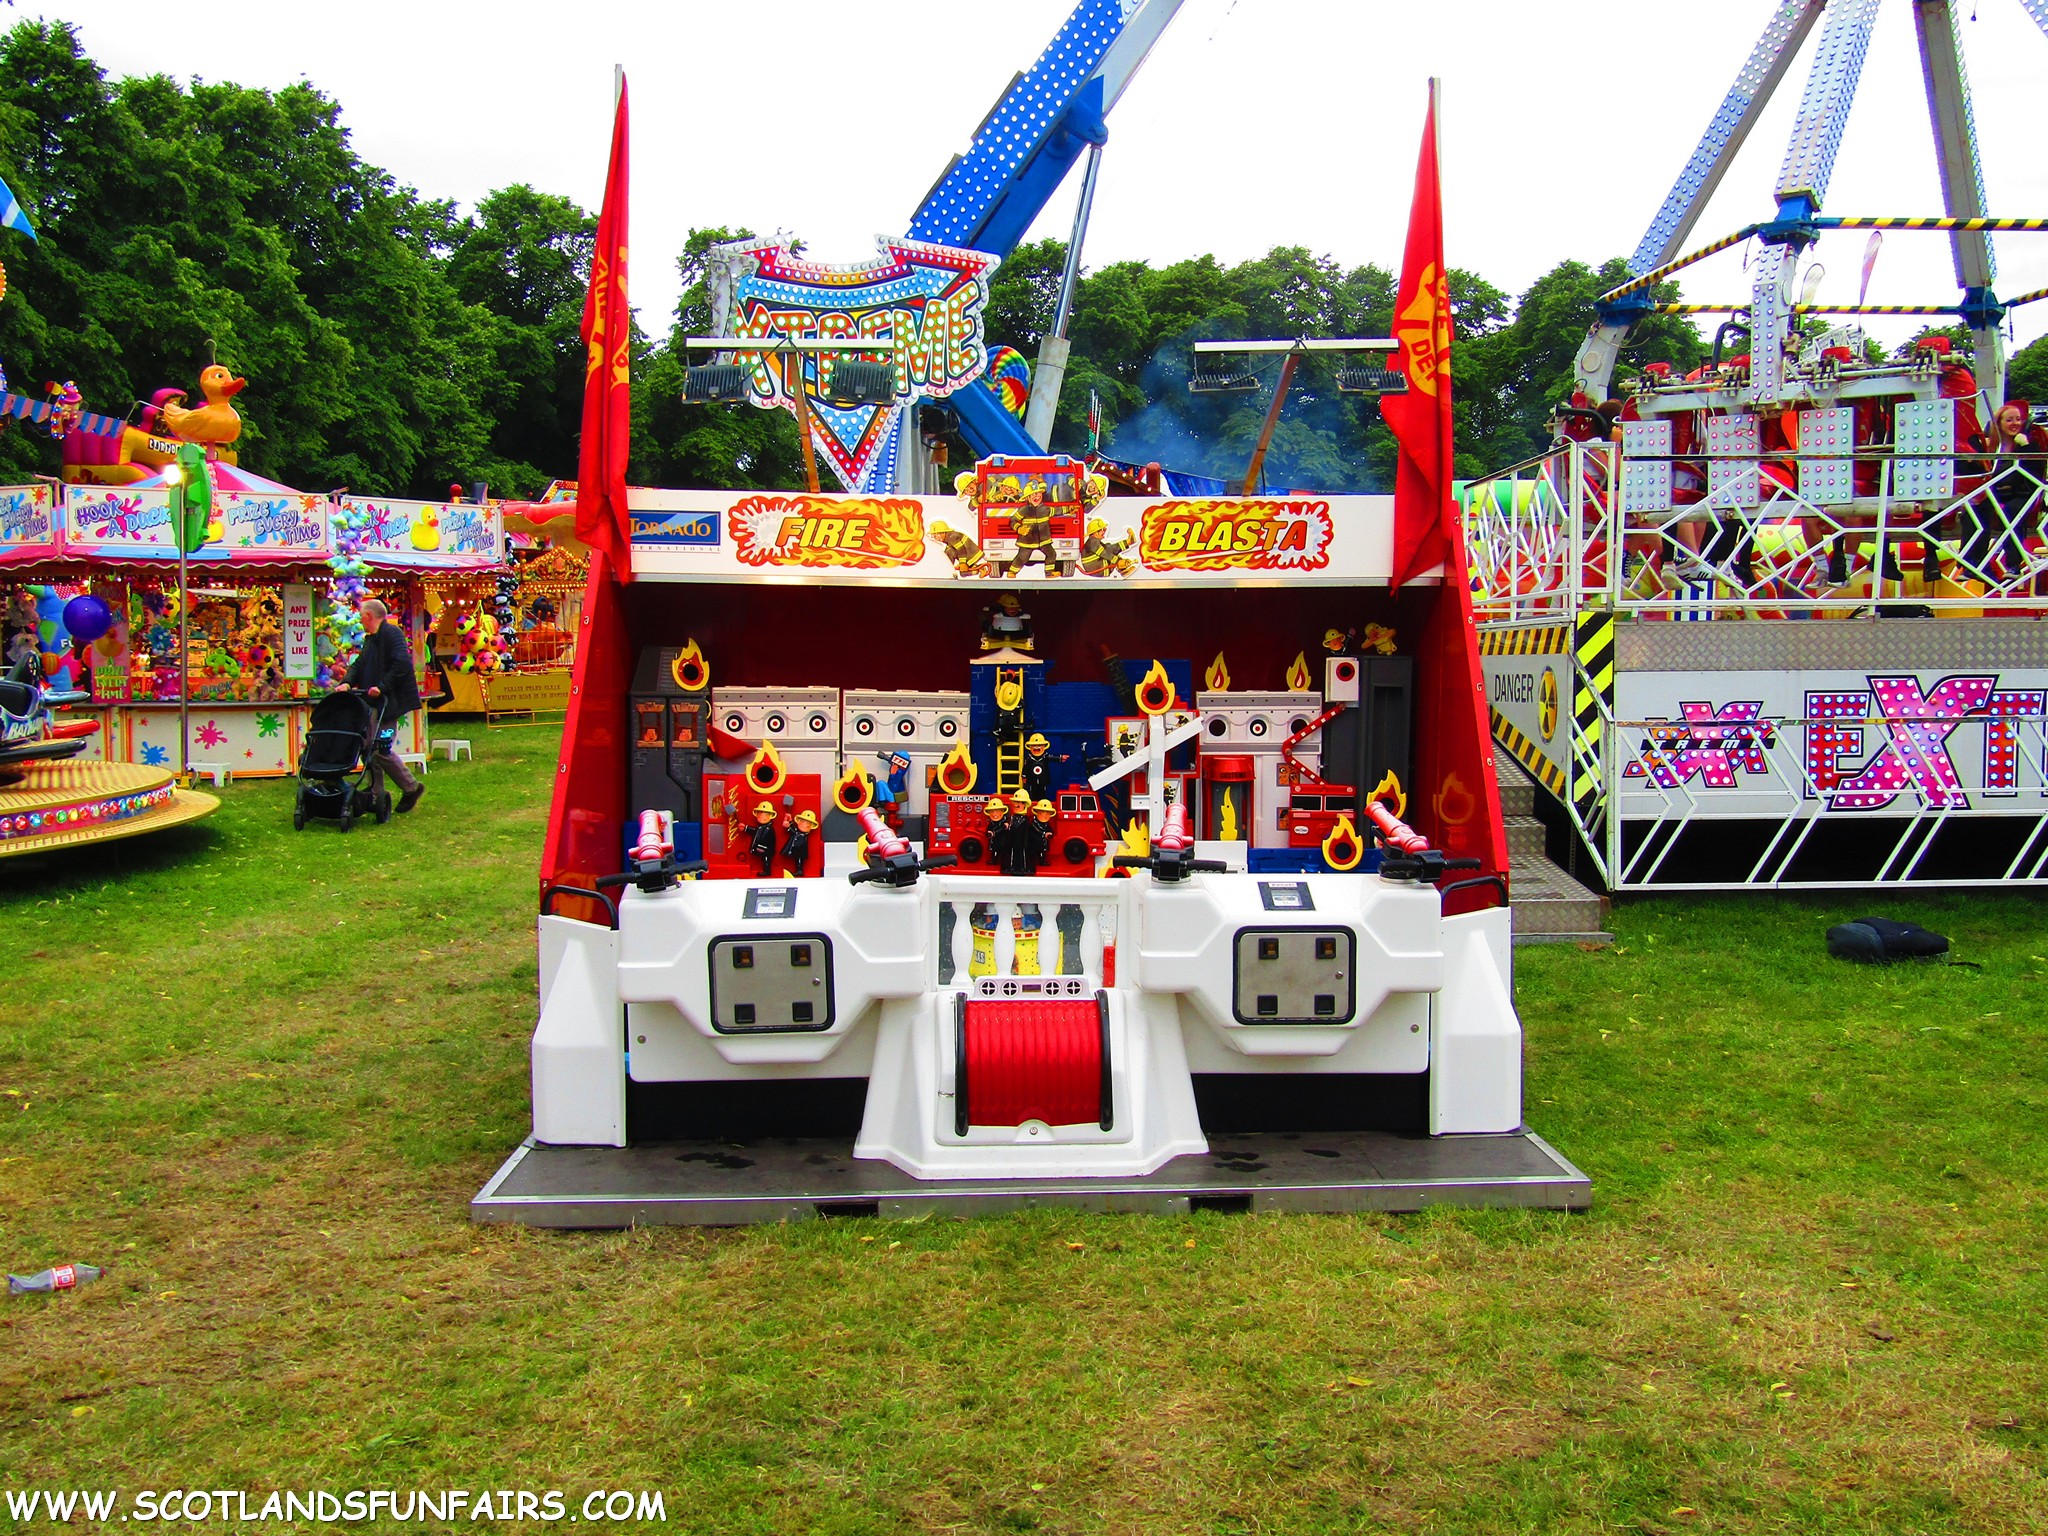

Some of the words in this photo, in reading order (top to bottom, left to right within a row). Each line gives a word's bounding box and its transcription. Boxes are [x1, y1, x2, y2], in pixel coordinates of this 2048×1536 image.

[75, 500, 125, 526] HOOK
[107, 518, 122, 537] A
[126, 506, 172, 532] DUCK
[227, 500, 270, 526] PRIZE
[253, 510, 299, 535] EVERY
[441, 511, 466, 534] PRIZE
[285, 522, 320, 546] TIME
[369, 528, 379, 546] A
[380, 515, 410, 541] DUCK
[629, 517, 711, 537] TORNADO
[775, 517, 871, 549] FIRE
[1158, 519, 1310, 551] BLASTA
[290, 606, 308, 614] ANY
[288, 619, 311, 628] PRIZE
[291, 646, 308, 655] LIKE
[1495, 674, 1534, 703] DANGER
